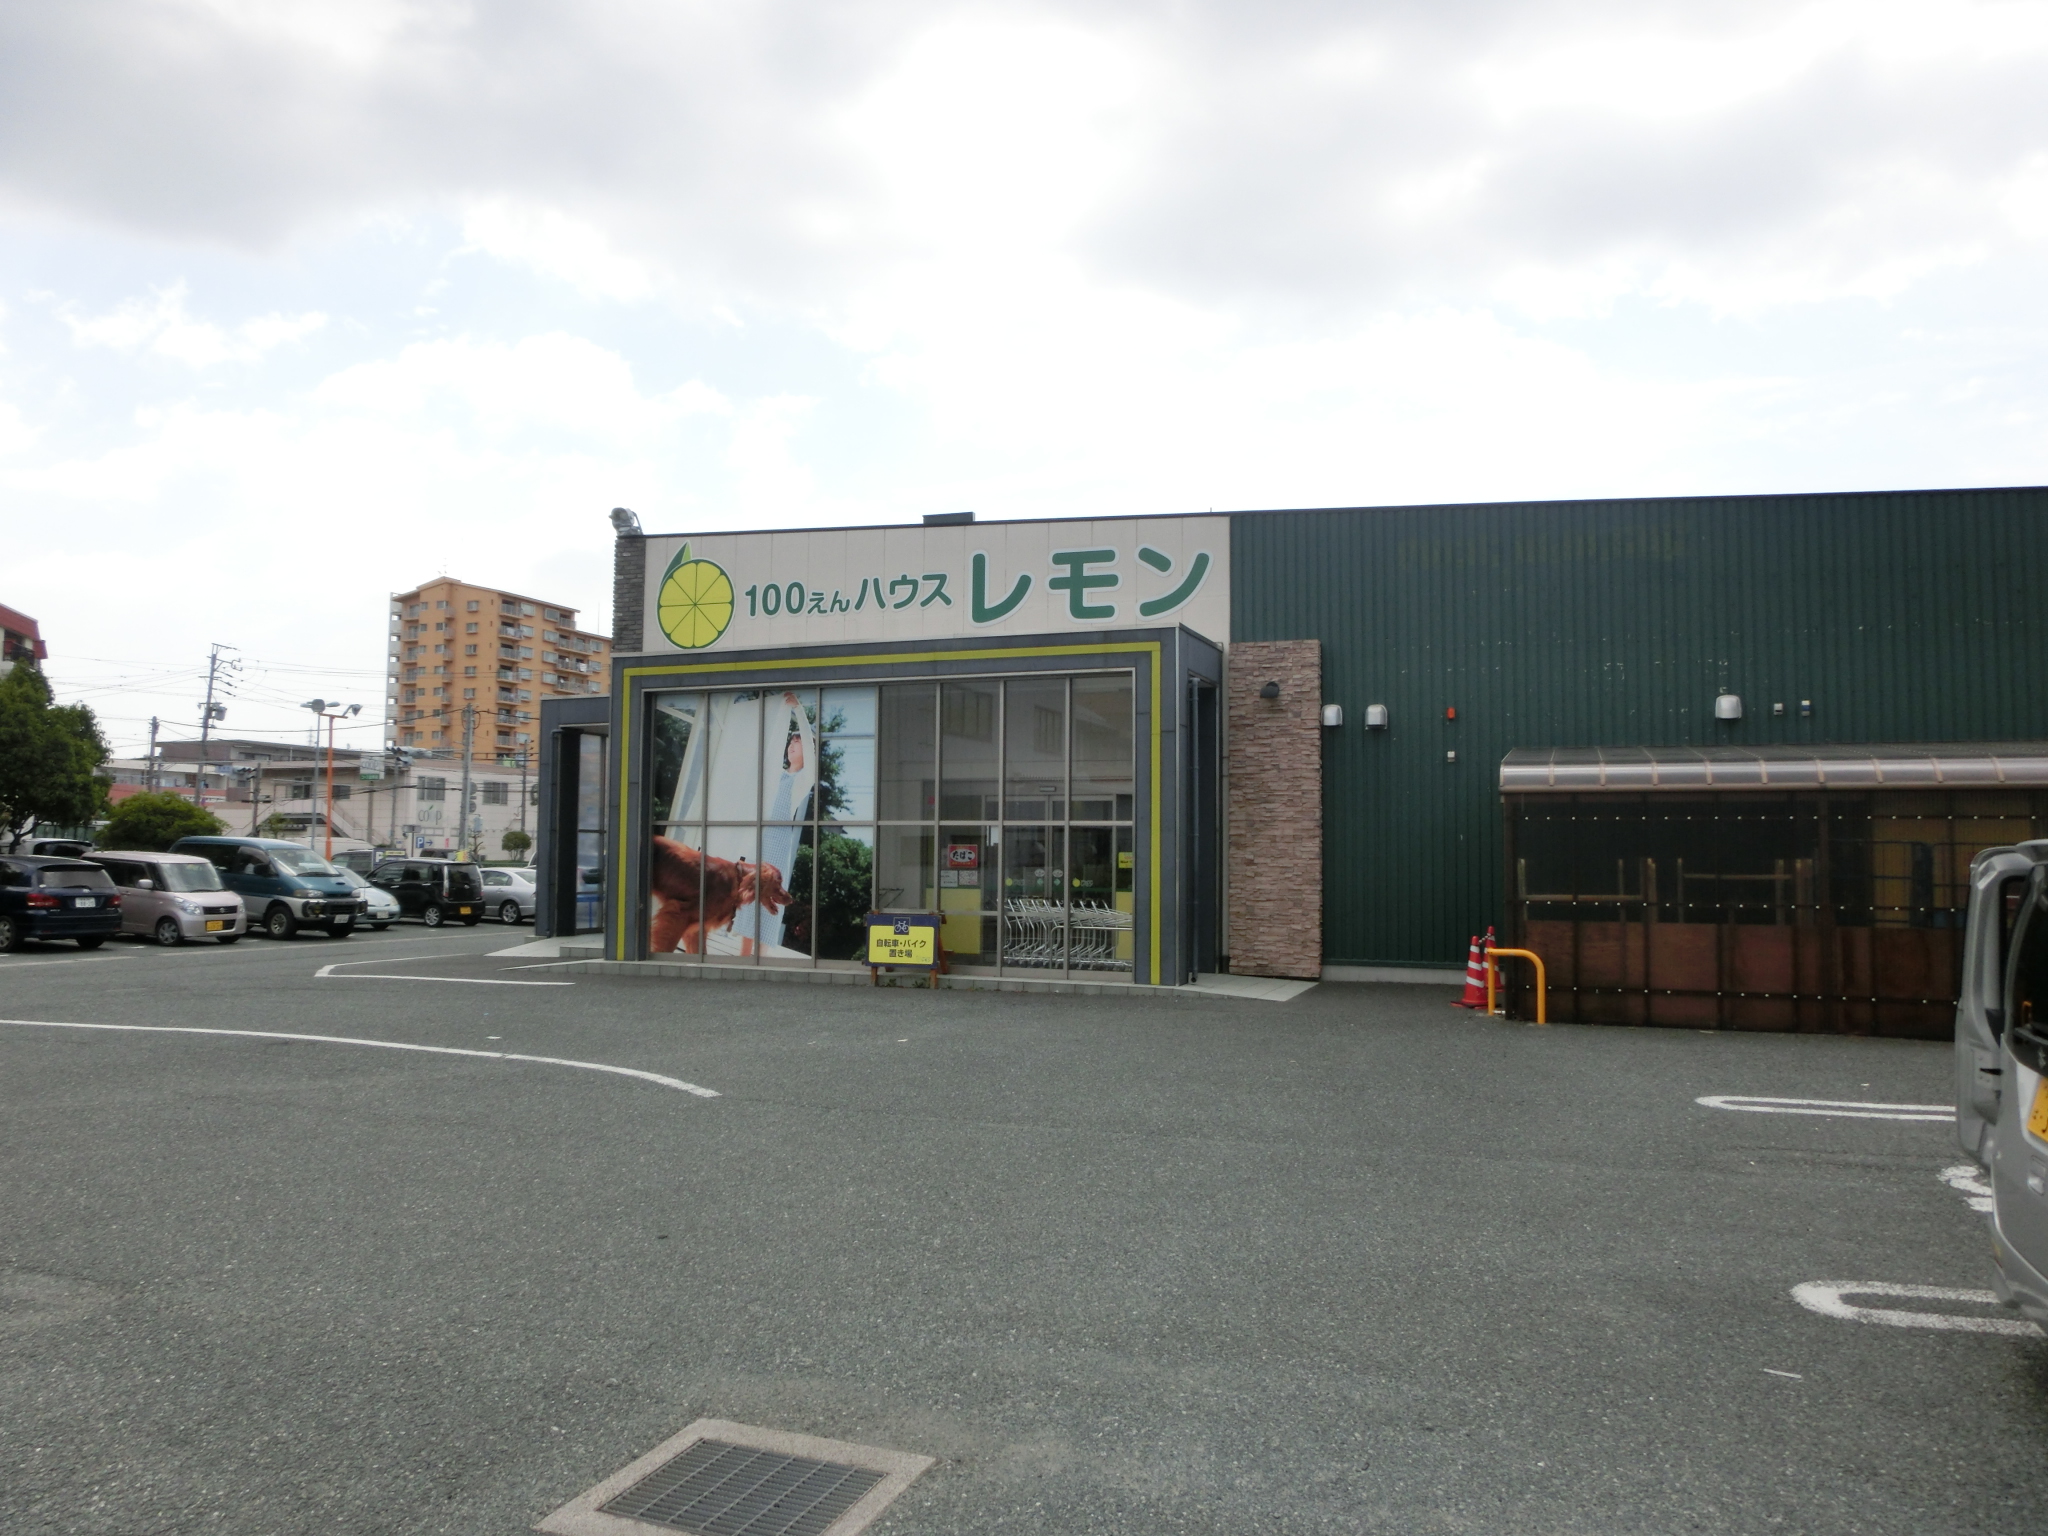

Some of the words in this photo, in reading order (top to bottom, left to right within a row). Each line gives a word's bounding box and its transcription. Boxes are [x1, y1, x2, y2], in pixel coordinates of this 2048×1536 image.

[745, 573, 952, 616] 100えんハウス
[972, 547, 1210, 623] レモン
[952, 850, 973, 860] たばこ
[876, 939, 927, 948] 自転車・バイク
[889, 949, 913, 958] 置き場
